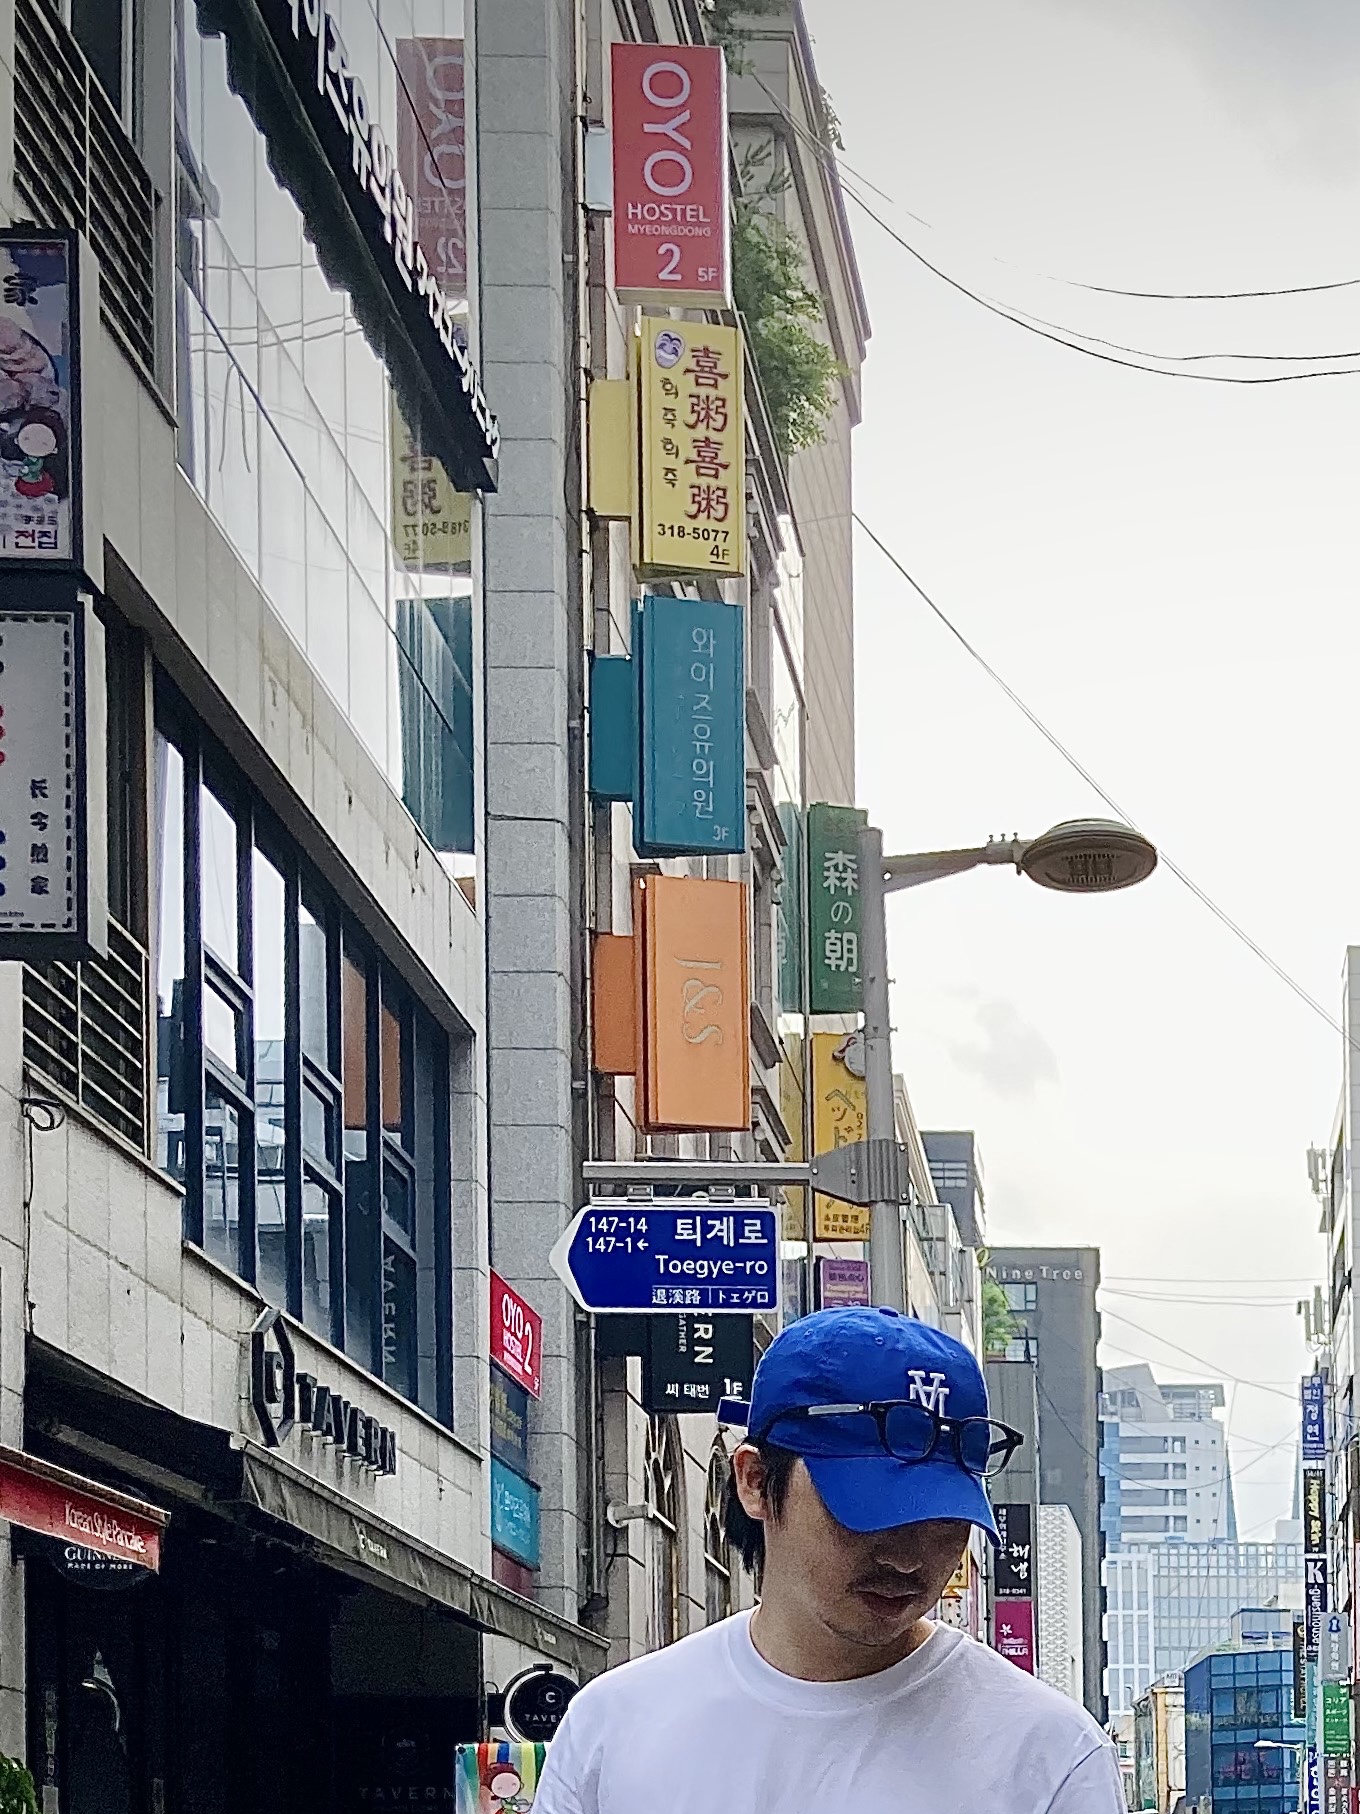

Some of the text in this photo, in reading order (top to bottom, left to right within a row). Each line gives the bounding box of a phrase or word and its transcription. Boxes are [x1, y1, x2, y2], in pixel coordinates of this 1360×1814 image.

[642, 60, 695, 197] OYO
[627, 203, 711, 224] HOSTEL
[627, 224, 712, 238] MYEONGDONG
[656, 243, 719, 283] 2 5F
[656, 523, 731, 544] 318-5077
[709, 543, 731, 561] 4F
[712, 825, 730, 842] 3F
[822, 850, 859, 973] 森の朝
[588, 1216, 648, 1234] 147-14
[674, 1215, 768, 1247] 퇴계로
[585, 1236, 633, 1253] 147-1
[655, 1254, 768, 1278] Toegye-ro
[986, 1265, 1084, 1280] Nine Tree
[652, 1288, 702, 1304] 退溪路
[502, 1293, 523, 1338] OYO
[523, 1326, 532, 1375] 2
[720, 1378, 743, 1397] 1F
